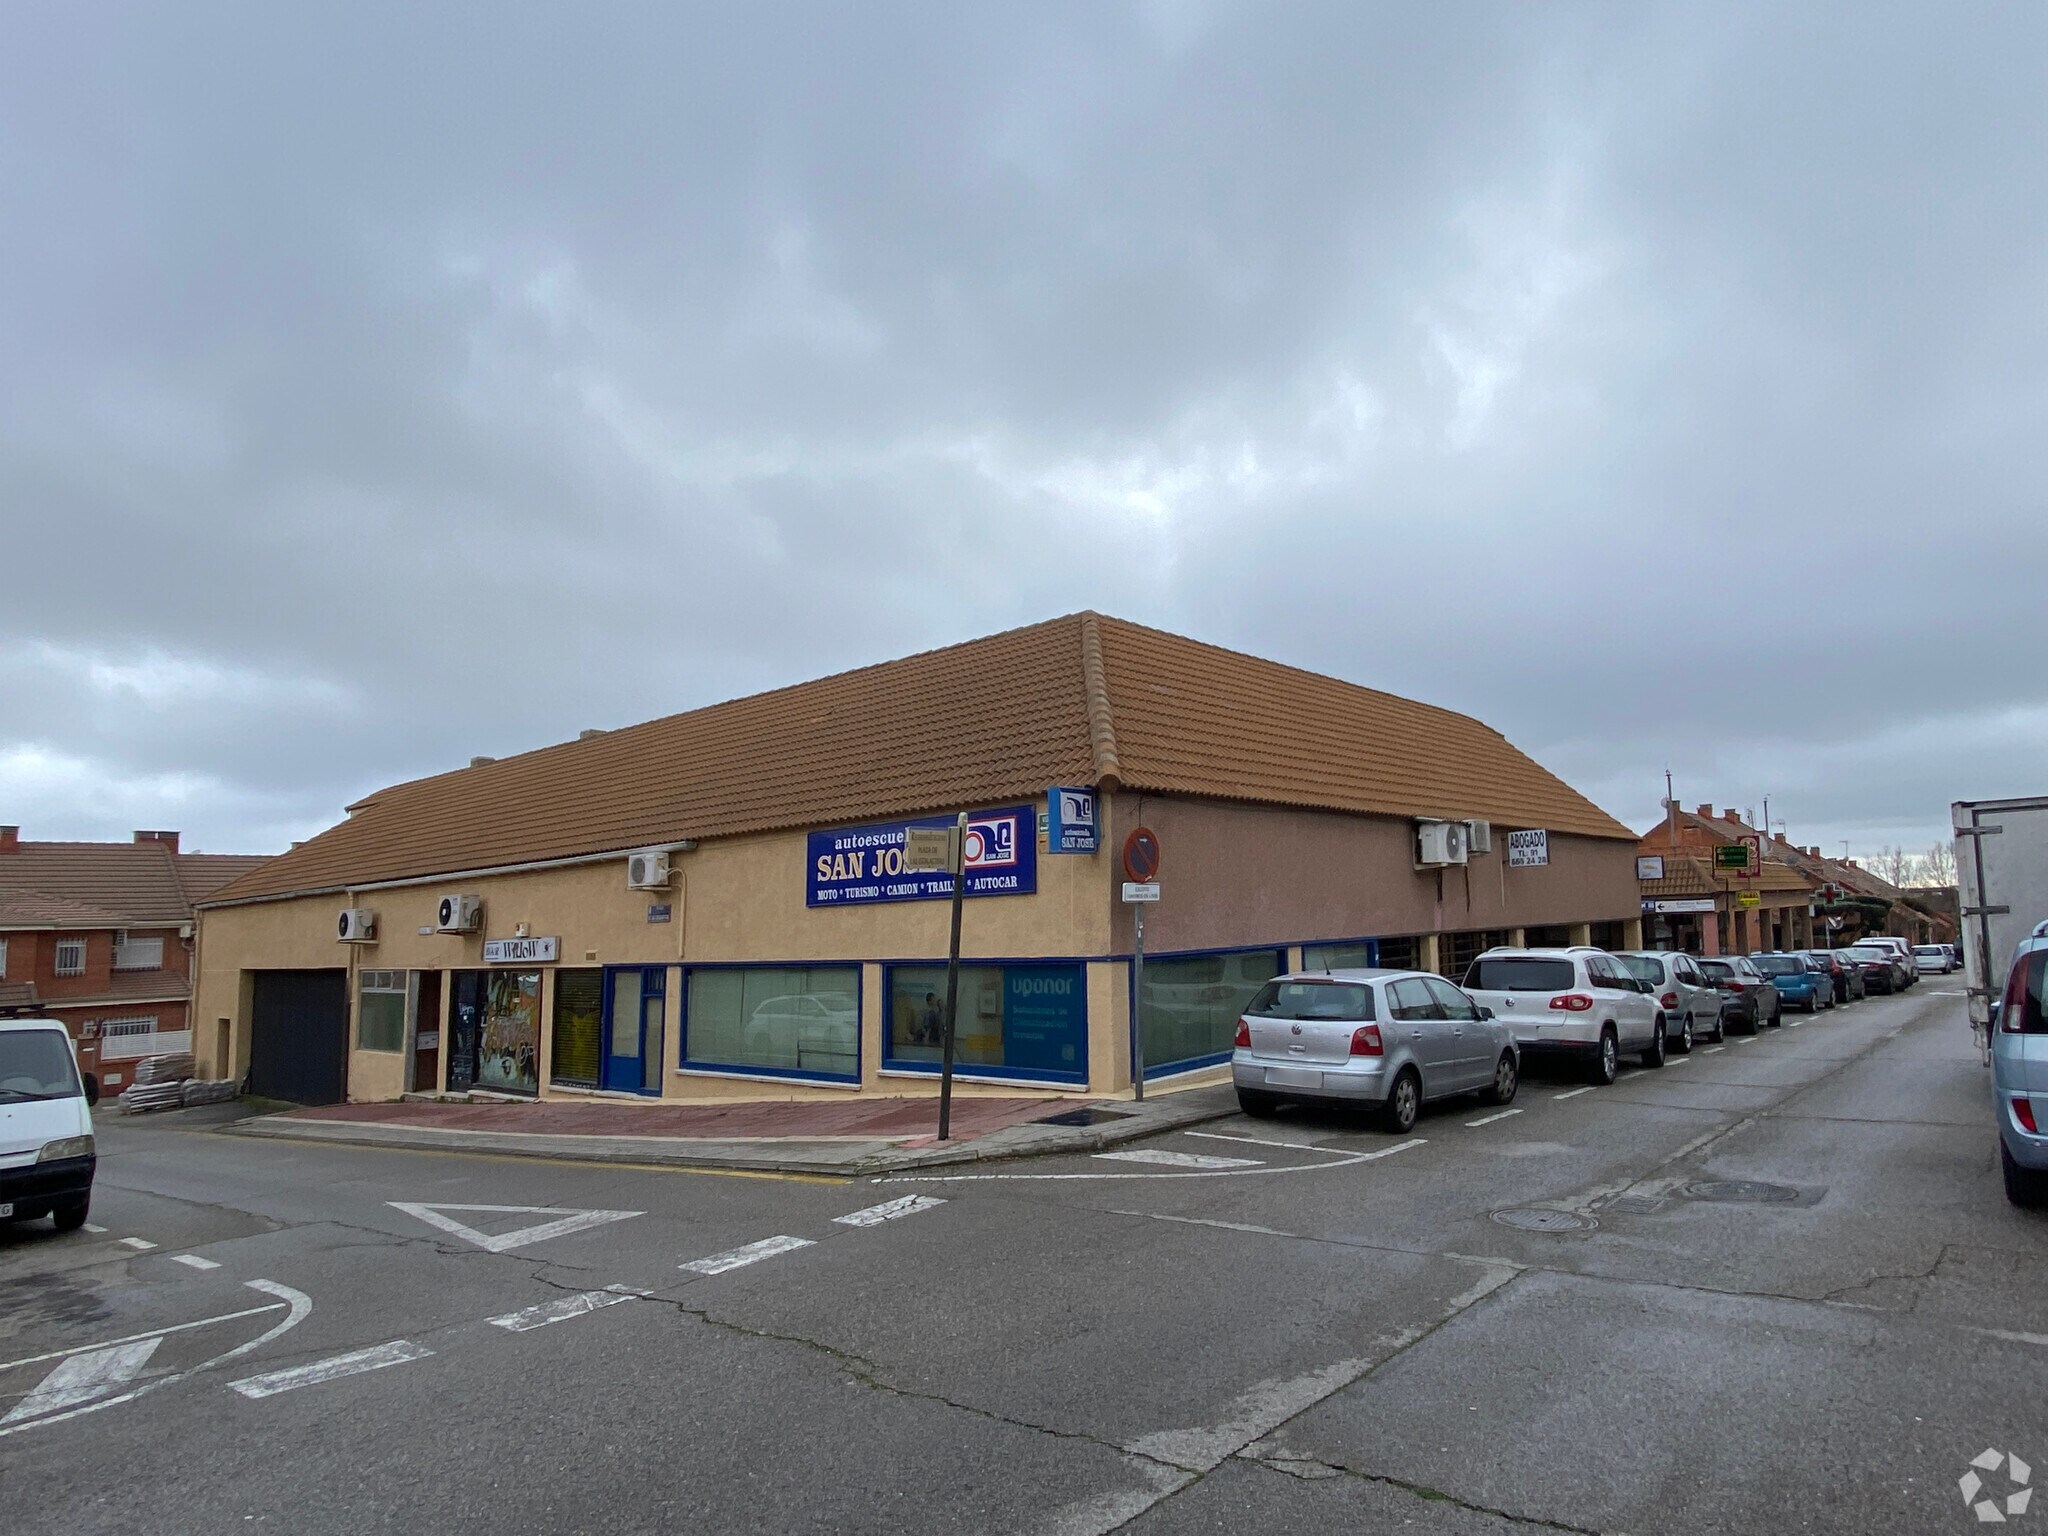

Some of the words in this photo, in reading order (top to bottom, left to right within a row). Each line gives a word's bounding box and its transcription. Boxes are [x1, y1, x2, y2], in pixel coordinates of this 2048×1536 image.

[835, 827, 910, 849] autoescuel
[1061, 837, 1076, 848] SAN
[1076, 837, 1094, 848] JOSE
[1510, 831, 1545, 848] ABOGADO
[817, 852, 865, 881] SAN
[872, 848, 938, 877] JO
[817, 889, 838, 900] MOTO
[845, 886, 879, 898] TURISMO
[887, 883, 918, 895] CAMION
[927, 880, 964, 893] TRAIL
[974, 876, 1018, 890] AUTOCAR
[1012, 976, 1073, 997] uponor
